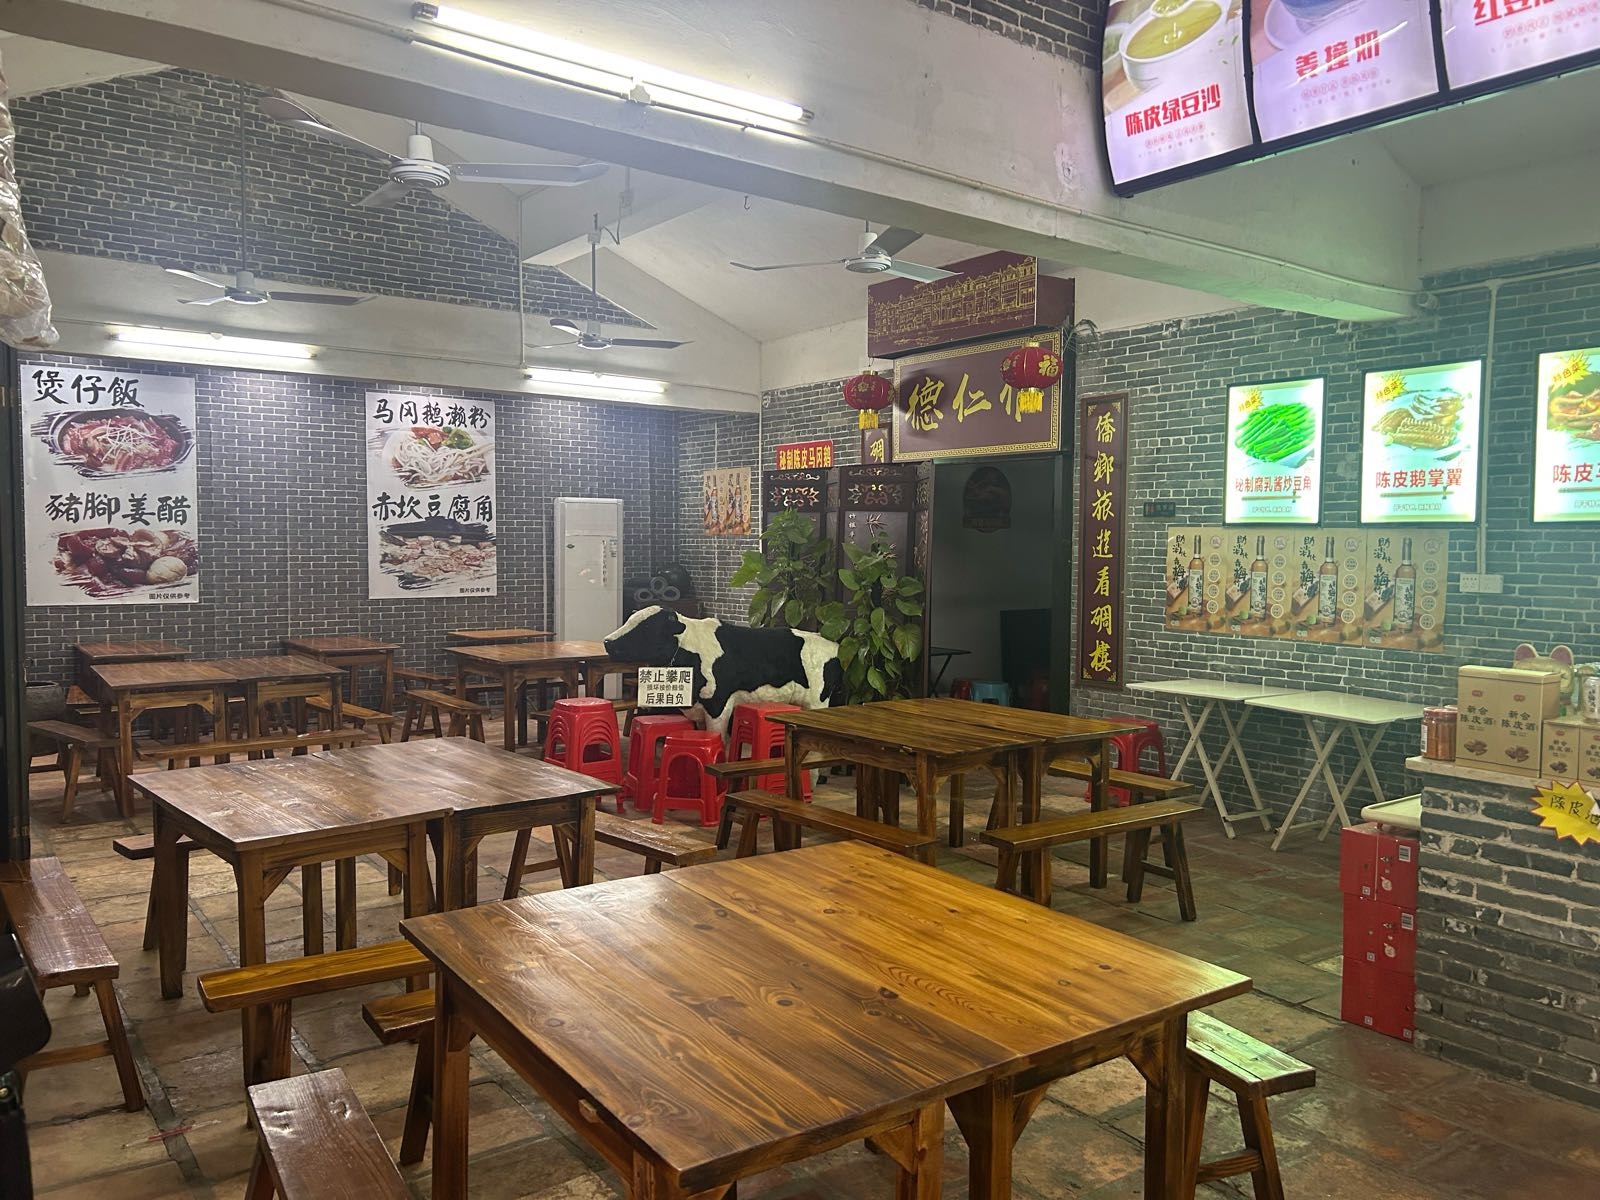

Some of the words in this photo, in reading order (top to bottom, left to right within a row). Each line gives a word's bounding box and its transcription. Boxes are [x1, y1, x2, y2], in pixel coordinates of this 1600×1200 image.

[1294, 29, 1382, 81] 姜撞奶
[1125, 83, 1221, 137] 陈皮绿豆沙
[1039, 354, 1059, 377] 福
[32, 369, 144, 407] 煲仔飯
[779, 445, 831, 470] 秘制陈皮马冈鹅
[1376, 468, 1463, 489] 陈皮鹅掌翼
[1553, 463, 1600, 484] 陈皮
[372, 492, 493, 523] 赤坎豆腐角
[149, 592, 190, 600] 图片仅供参考
[640, 669, 691, 684] 禁止攀爬
[646, 692, 684, 705] 后果自负
